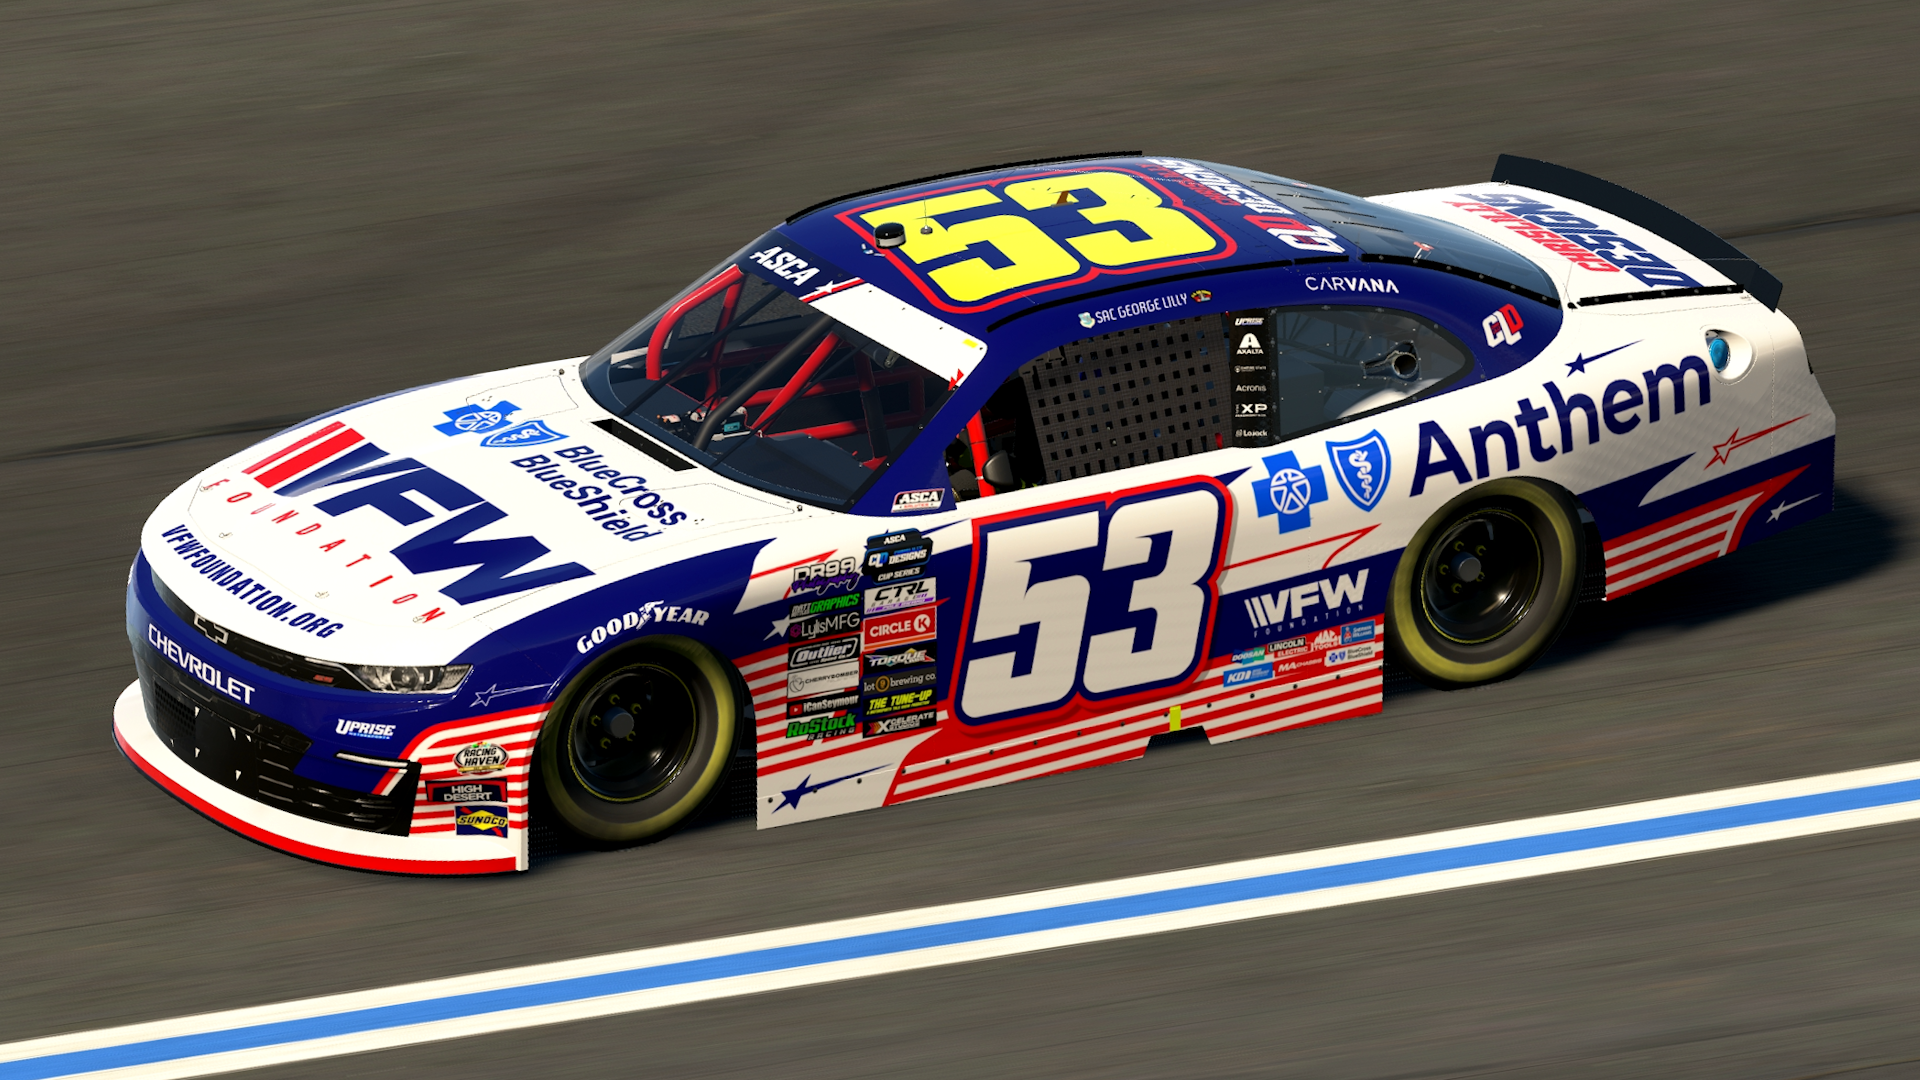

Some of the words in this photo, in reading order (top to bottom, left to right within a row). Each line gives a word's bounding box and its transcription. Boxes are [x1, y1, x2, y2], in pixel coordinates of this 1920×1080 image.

[859, 172, 1217, 302] 53
[1456, 193, 1705, 288] DESIGNS
[749, 246, 820, 286] ASCA
[1305, 276, 1399, 294] CARVANA
[1095, 308, 1117, 324] SAC
[1117, 298, 1161, 319] GEORGE
[1162, 293, 1187, 308] LILLY
[1409, 355, 1711, 497] Anthem
[554, 445, 687, 526] BlueCross
[510, 454, 663, 542] BlueShield
[899, 491, 939, 504] ASCA
[273, 442, 597, 606] VFW
[884, 534, 906, 545] ASCA
[212, 478, 446, 624] FOUNDATION
[888, 549, 927, 565] DESIGNS
[161, 524, 344, 638] VFWFOUNDATION.ORG
[878, 571, 893, 582] CUP
[893, 567, 920, 579] SERIES
[874, 581, 929, 601] CTRL
[1260, 568, 1369, 625] VFW
[961, 490, 1218, 718] 53
[870, 620, 911, 637] CIRCLE
[915, 615, 930, 632] K
[1254, 604, 1363, 638] FOUNDATION
[796, 644, 852, 663] Outlier
[1269, 638, 1304, 652] LINCOLN
[1277, 646, 1308, 657] ELECTRIC
[149, 623, 255, 705] CHEVROLET
[869, 649, 927, 667] TORQUE
[1231, 649, 1265, 662] DOOSAN
[805, 670, 859, 684] CHERRYBOMBER
[864, 682, 875, 692] lot
[890, 675, 923, 687] brewing
[925, 673, 937, 681] co.
[803, 695, 859, 713] iCanSeymour
[869, 697, 888, 710] THE
[891, 689, 933, 706] TUNE-UP
[335, 718, 396, 736] UPRISE
[808, 727, 855, 741] RACING
[464, 747, 497, 757] RACING
[464, 756, 500, 766] HAVEN
[443, 792, 493, 801] DESERT
[451, 784, 482, 793] HIGH
[459, 815, 507, 827] SUNOCO
